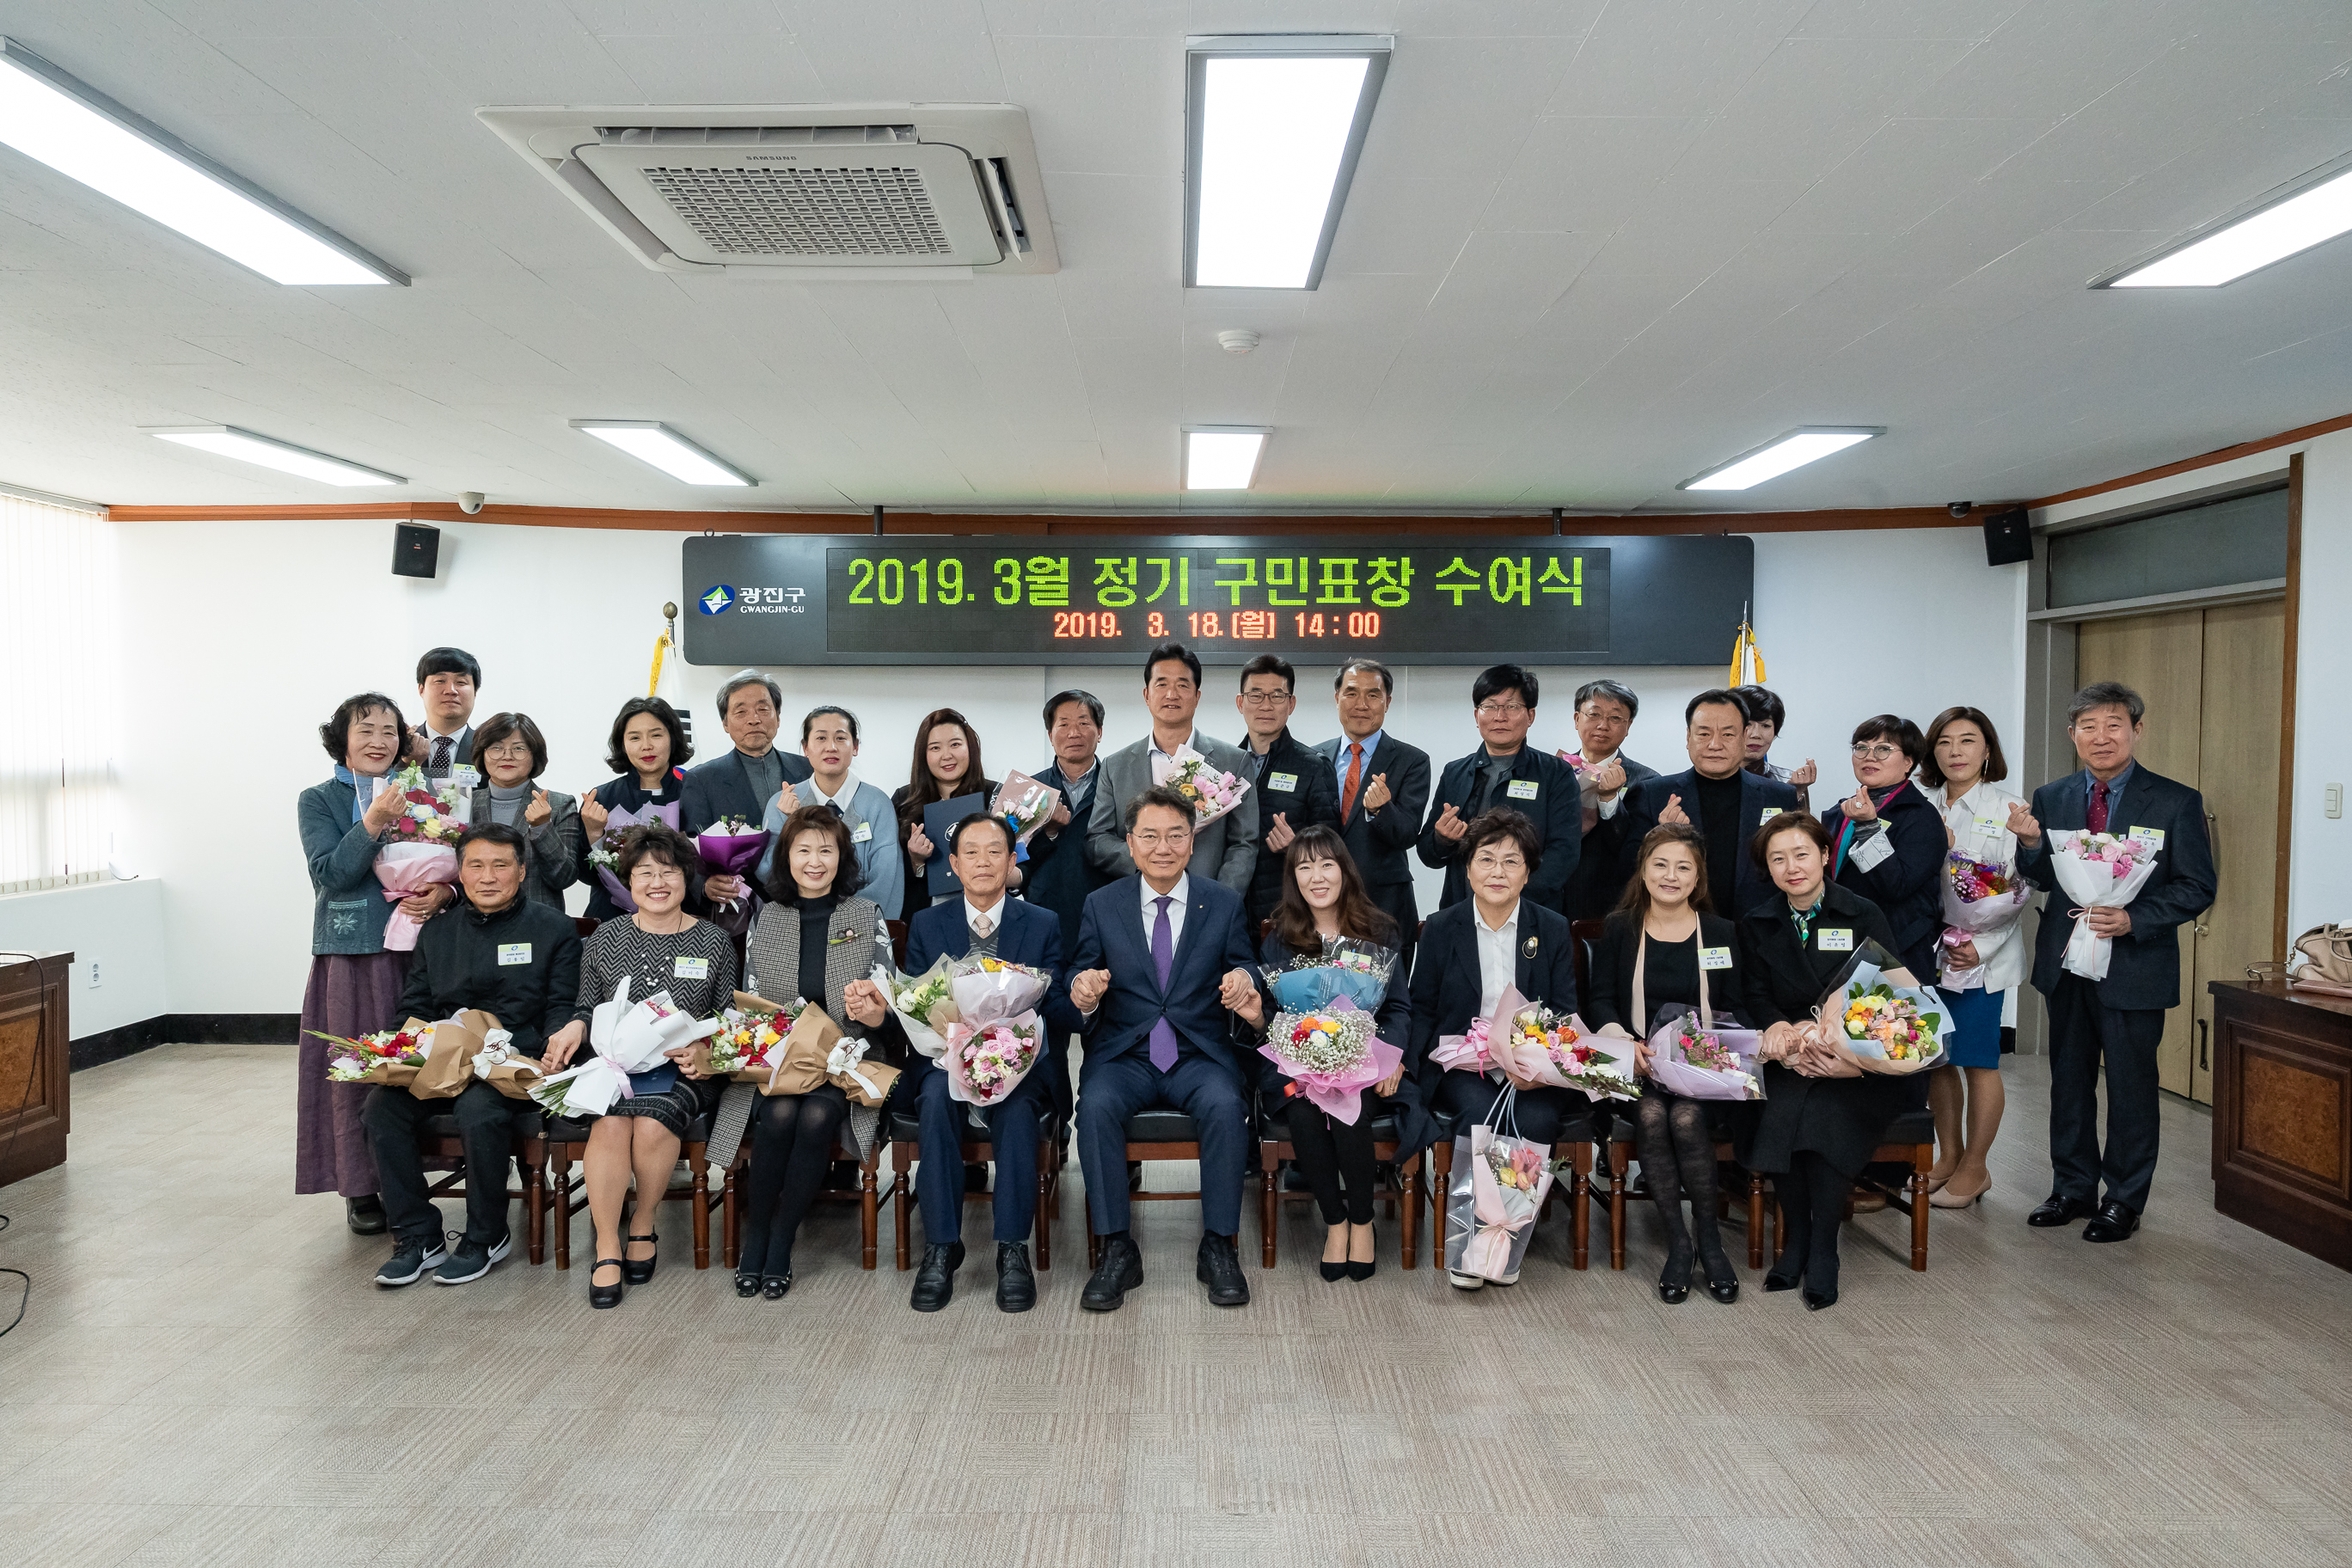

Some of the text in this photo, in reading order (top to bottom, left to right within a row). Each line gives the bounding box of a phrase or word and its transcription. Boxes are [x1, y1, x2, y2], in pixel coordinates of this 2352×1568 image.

[848, 555, 1583, 608] 2019. 3월 정기 구민표창 수여식
[738, 587, 806, 604] 광진구
[739, 605, 805, 614] GWANGJIN-GU
[1053, 611, 1123, 638] 2019.
[1147, 611, 1170, 638] 3.
